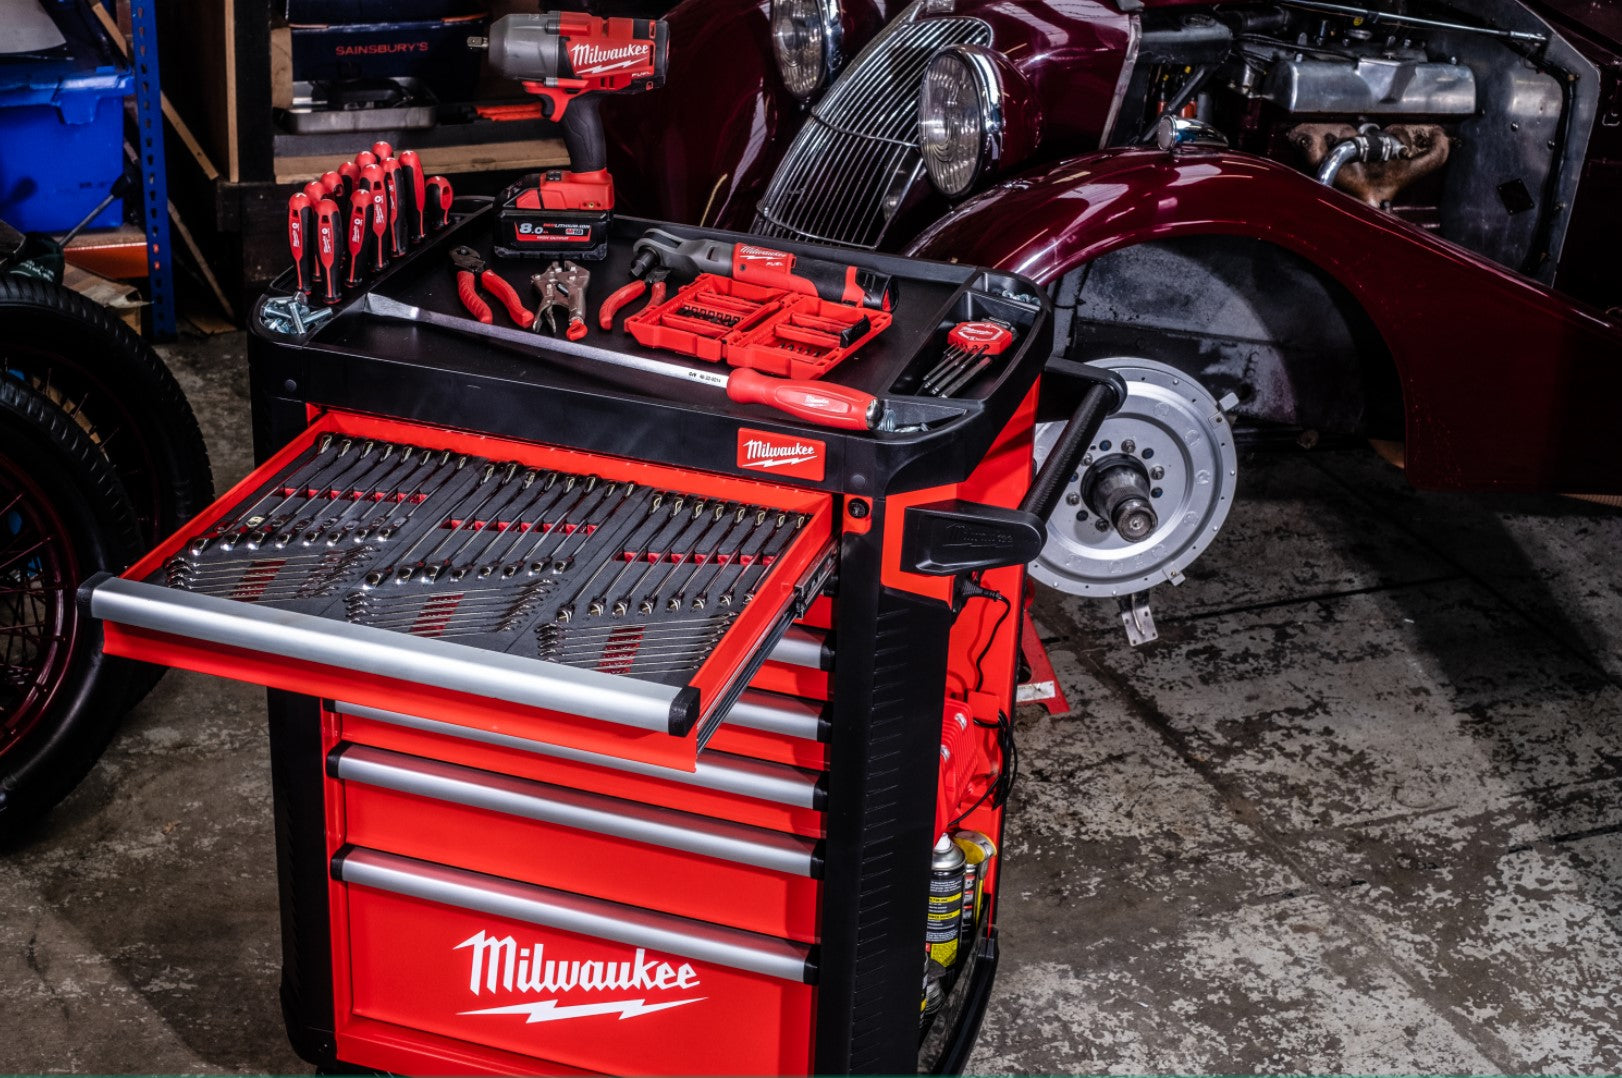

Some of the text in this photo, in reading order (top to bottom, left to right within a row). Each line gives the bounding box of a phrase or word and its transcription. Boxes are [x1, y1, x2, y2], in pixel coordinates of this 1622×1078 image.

[336, 42, 429, 56] SAINSBURY'S
[570, 43, 649, 67] Milwaukee
[519, 222, 544, 235] 8.0
[740, 245, 788, 258] Milwaukee
[742, 439, 815, 460] Milwaukee
[452, 929, 701, 997] Milwaukee
